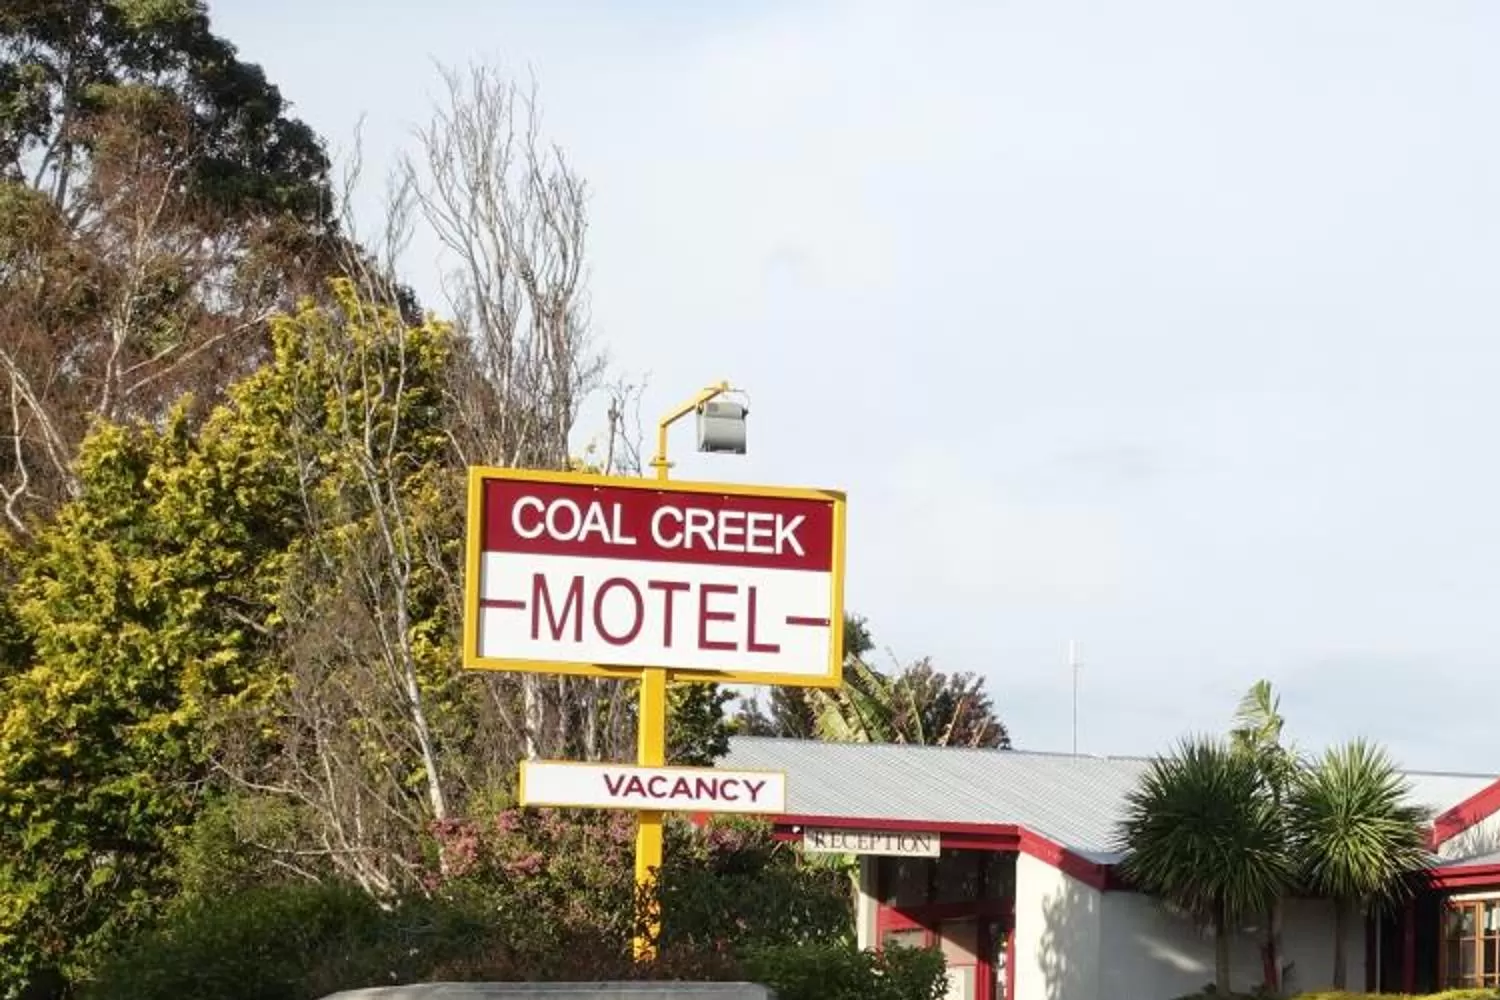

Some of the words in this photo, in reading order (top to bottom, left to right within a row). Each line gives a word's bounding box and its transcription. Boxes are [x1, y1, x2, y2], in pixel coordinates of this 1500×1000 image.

[511, 495, 637, 546] COAL
[650, 505, 806, 556] CREEK
[529, 572, 781, 654] MOTEL
[602, 772, 767, 803] VACANCY
[814, 830, 931, 852] RECEPTION
